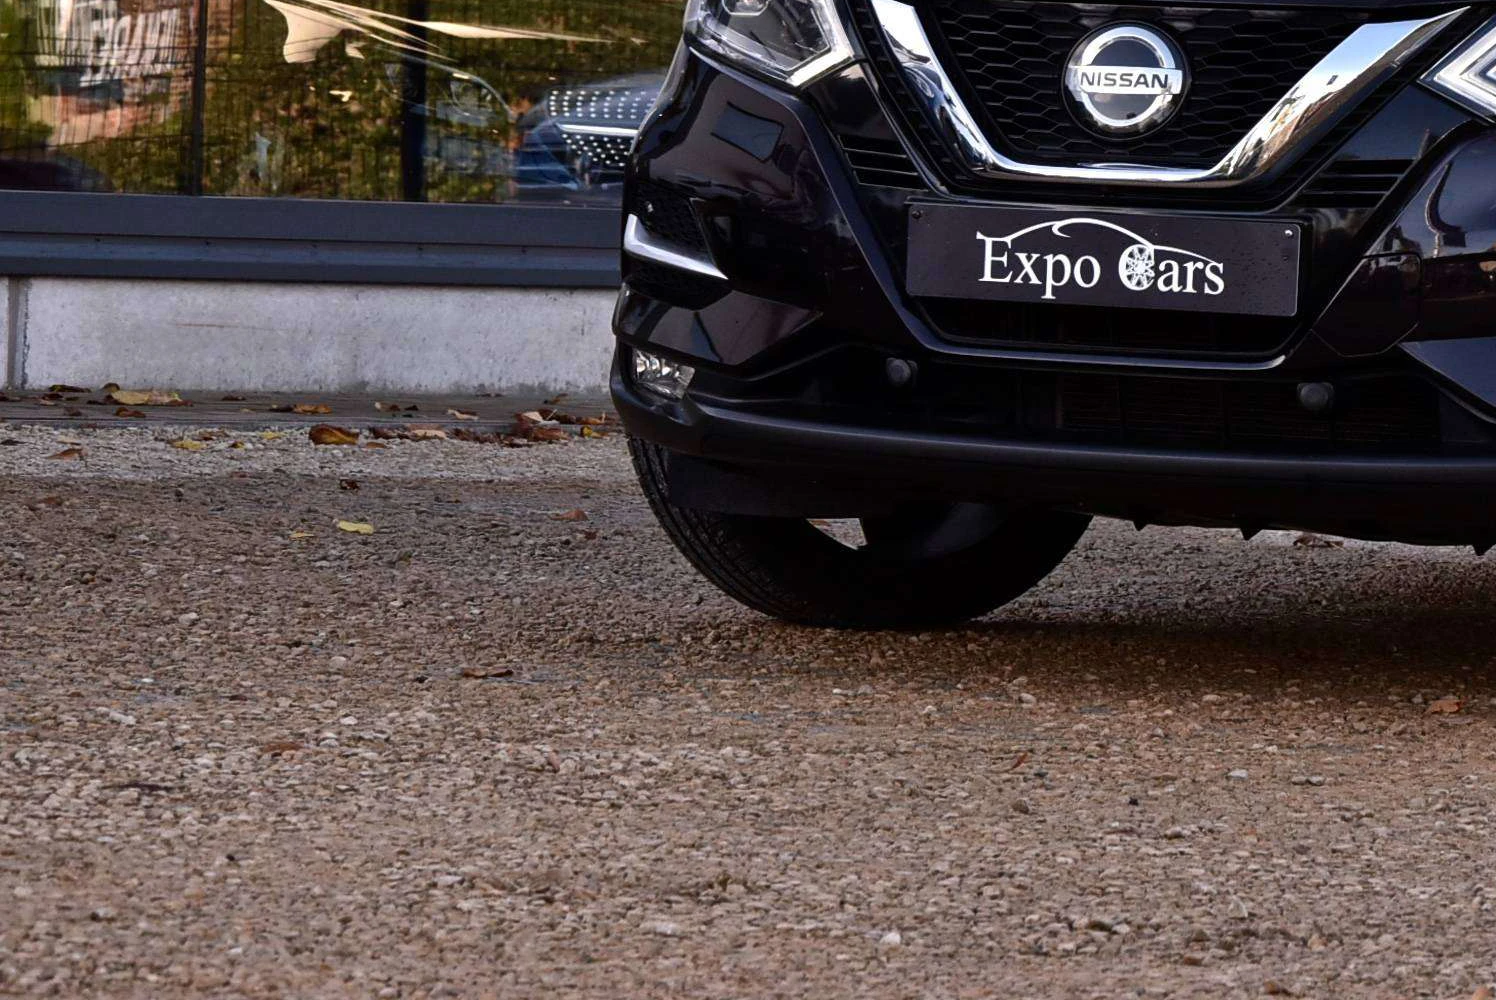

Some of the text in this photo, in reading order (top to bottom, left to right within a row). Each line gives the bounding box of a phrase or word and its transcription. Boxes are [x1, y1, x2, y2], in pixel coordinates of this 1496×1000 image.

[1080, 71, 1168, 89] NISSAN
[977, 236, 1225, 299] Expo Cars
